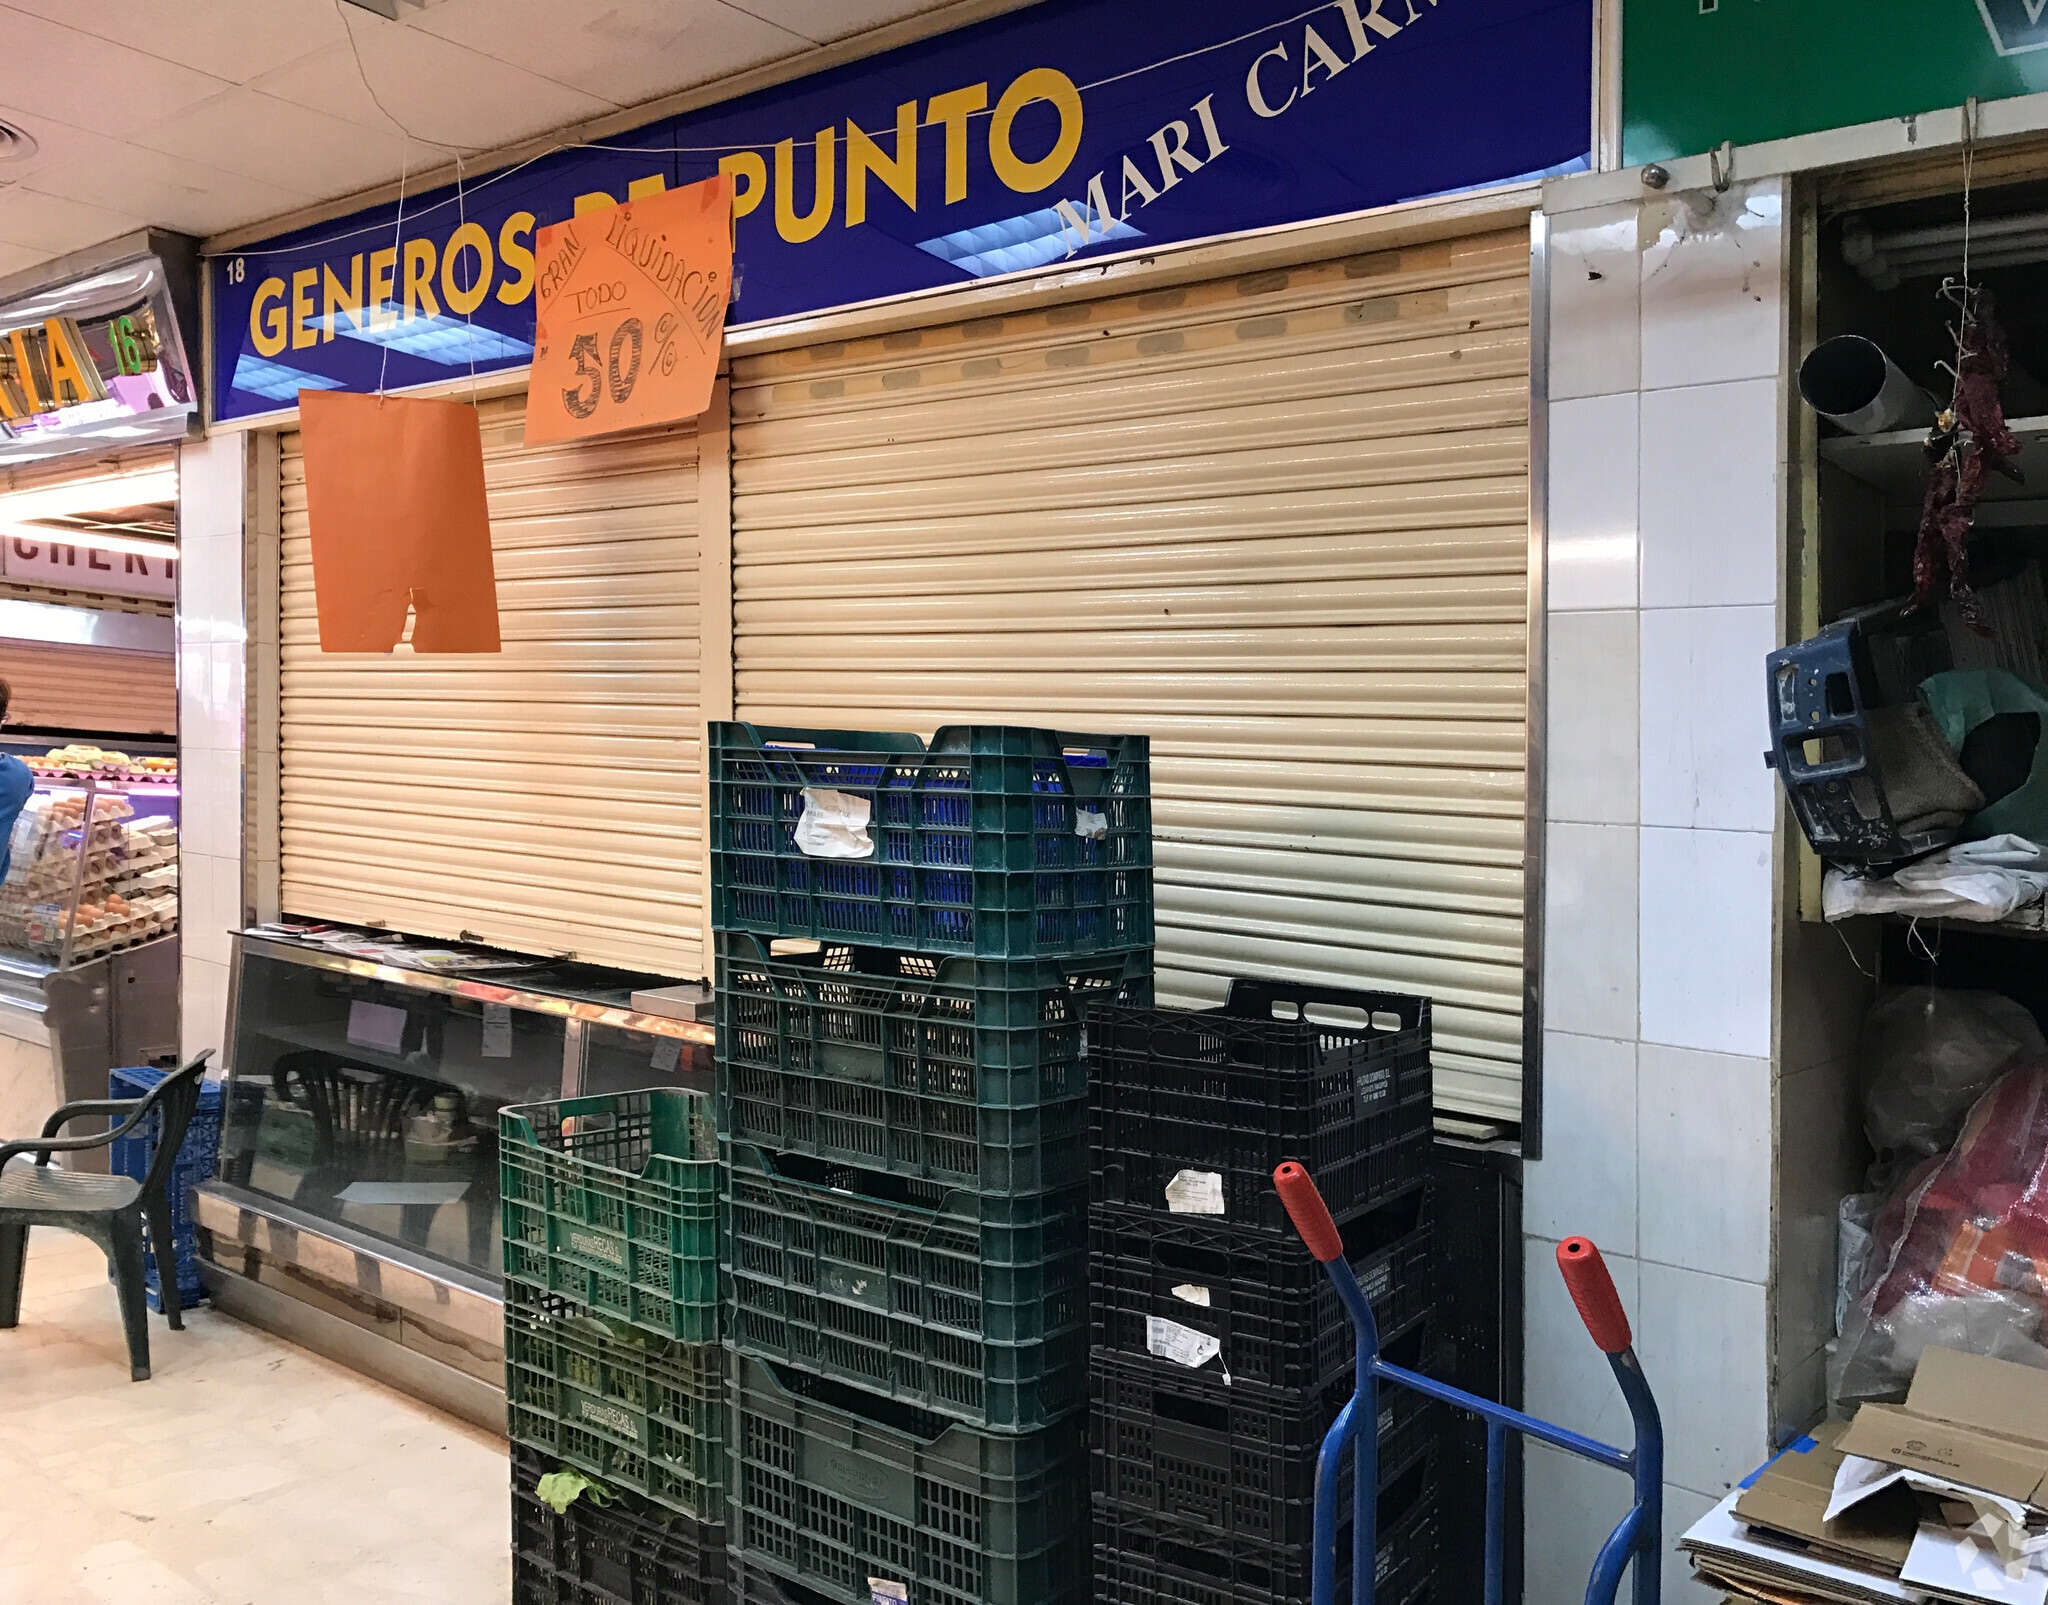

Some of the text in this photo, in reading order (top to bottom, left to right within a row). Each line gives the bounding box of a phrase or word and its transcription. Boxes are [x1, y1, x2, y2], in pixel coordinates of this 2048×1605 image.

[1051, 0, 1437, 260] MARI CAR
[250, 67, 1084, 358] GENEROS PUNTO
[226, 257, 246, 286] 18
[541, 224, 581, 300] GRAN
[564, 281, 627, 314] TODO
[0, 315, 144, 420] IA 16
